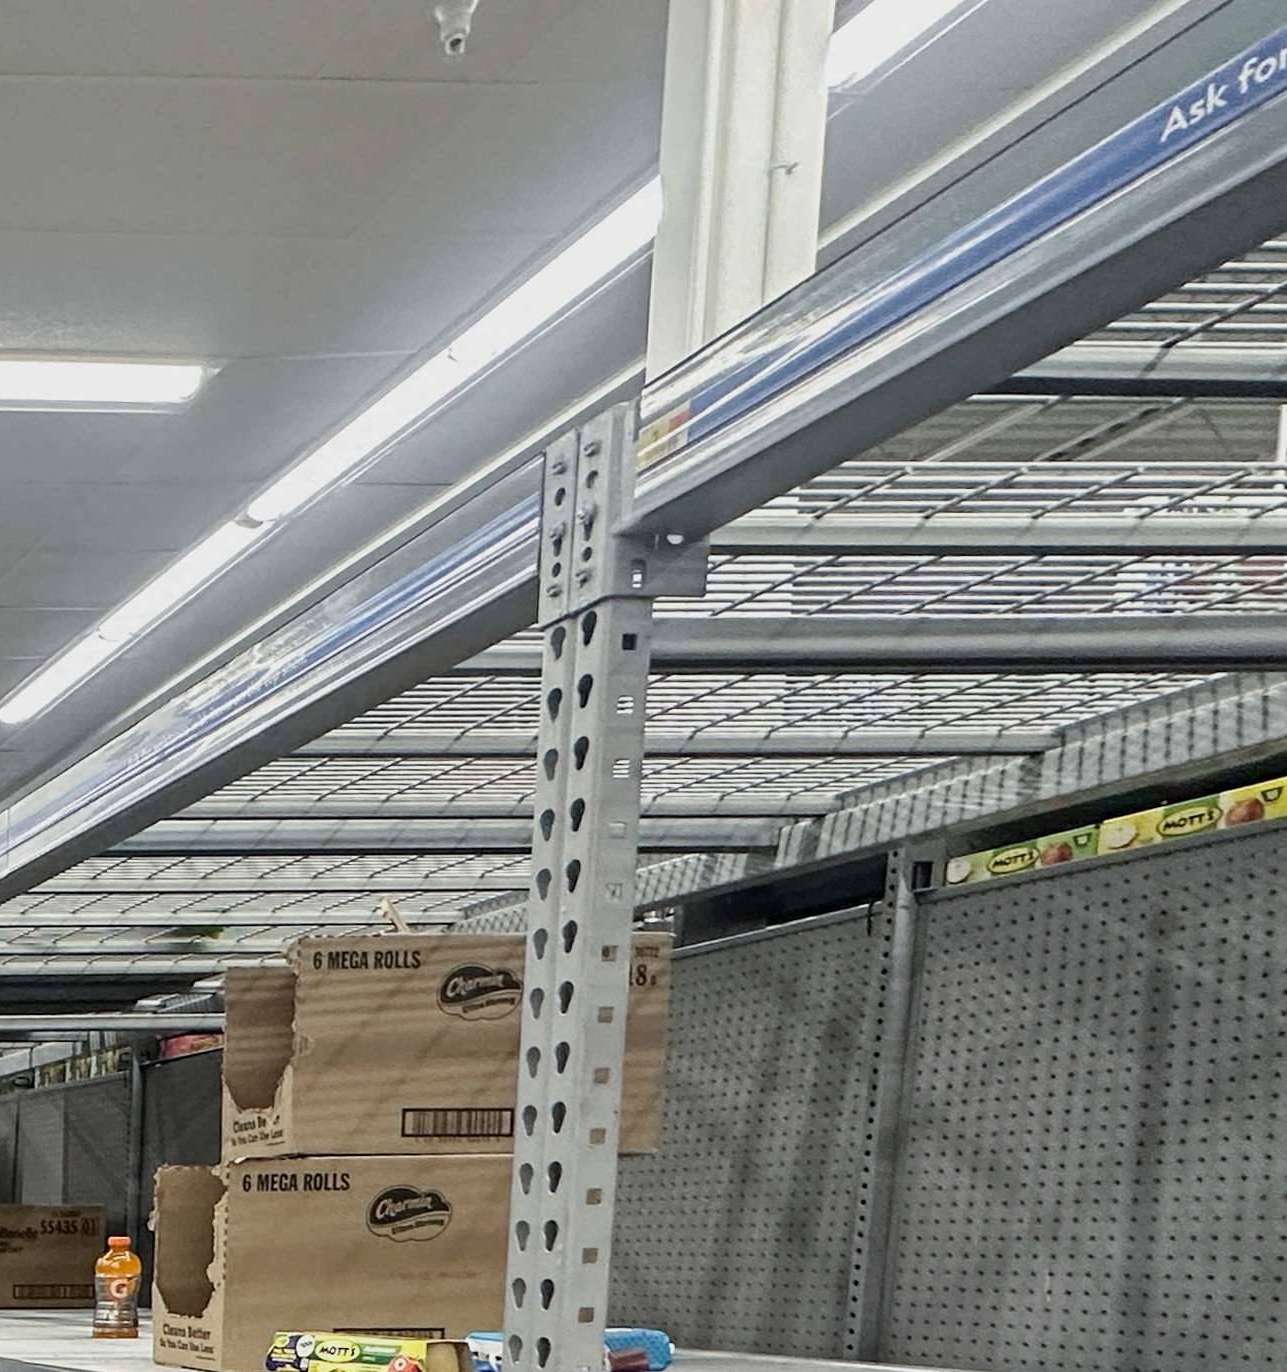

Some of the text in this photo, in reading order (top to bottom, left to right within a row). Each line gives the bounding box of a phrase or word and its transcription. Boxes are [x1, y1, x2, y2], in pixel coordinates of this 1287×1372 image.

[1159, 82, 1230, 143] Ask
[1164, 810, 1215, 831] MOTT'S
[313, 950, 421, 970] 6 MEGA ROLLS
[242, 1173, 350, 1192] 6 MEGA ROLLS
[111, 1279, 128, 1298] G
[321, 1345, 356, 1357] MOTT'S
